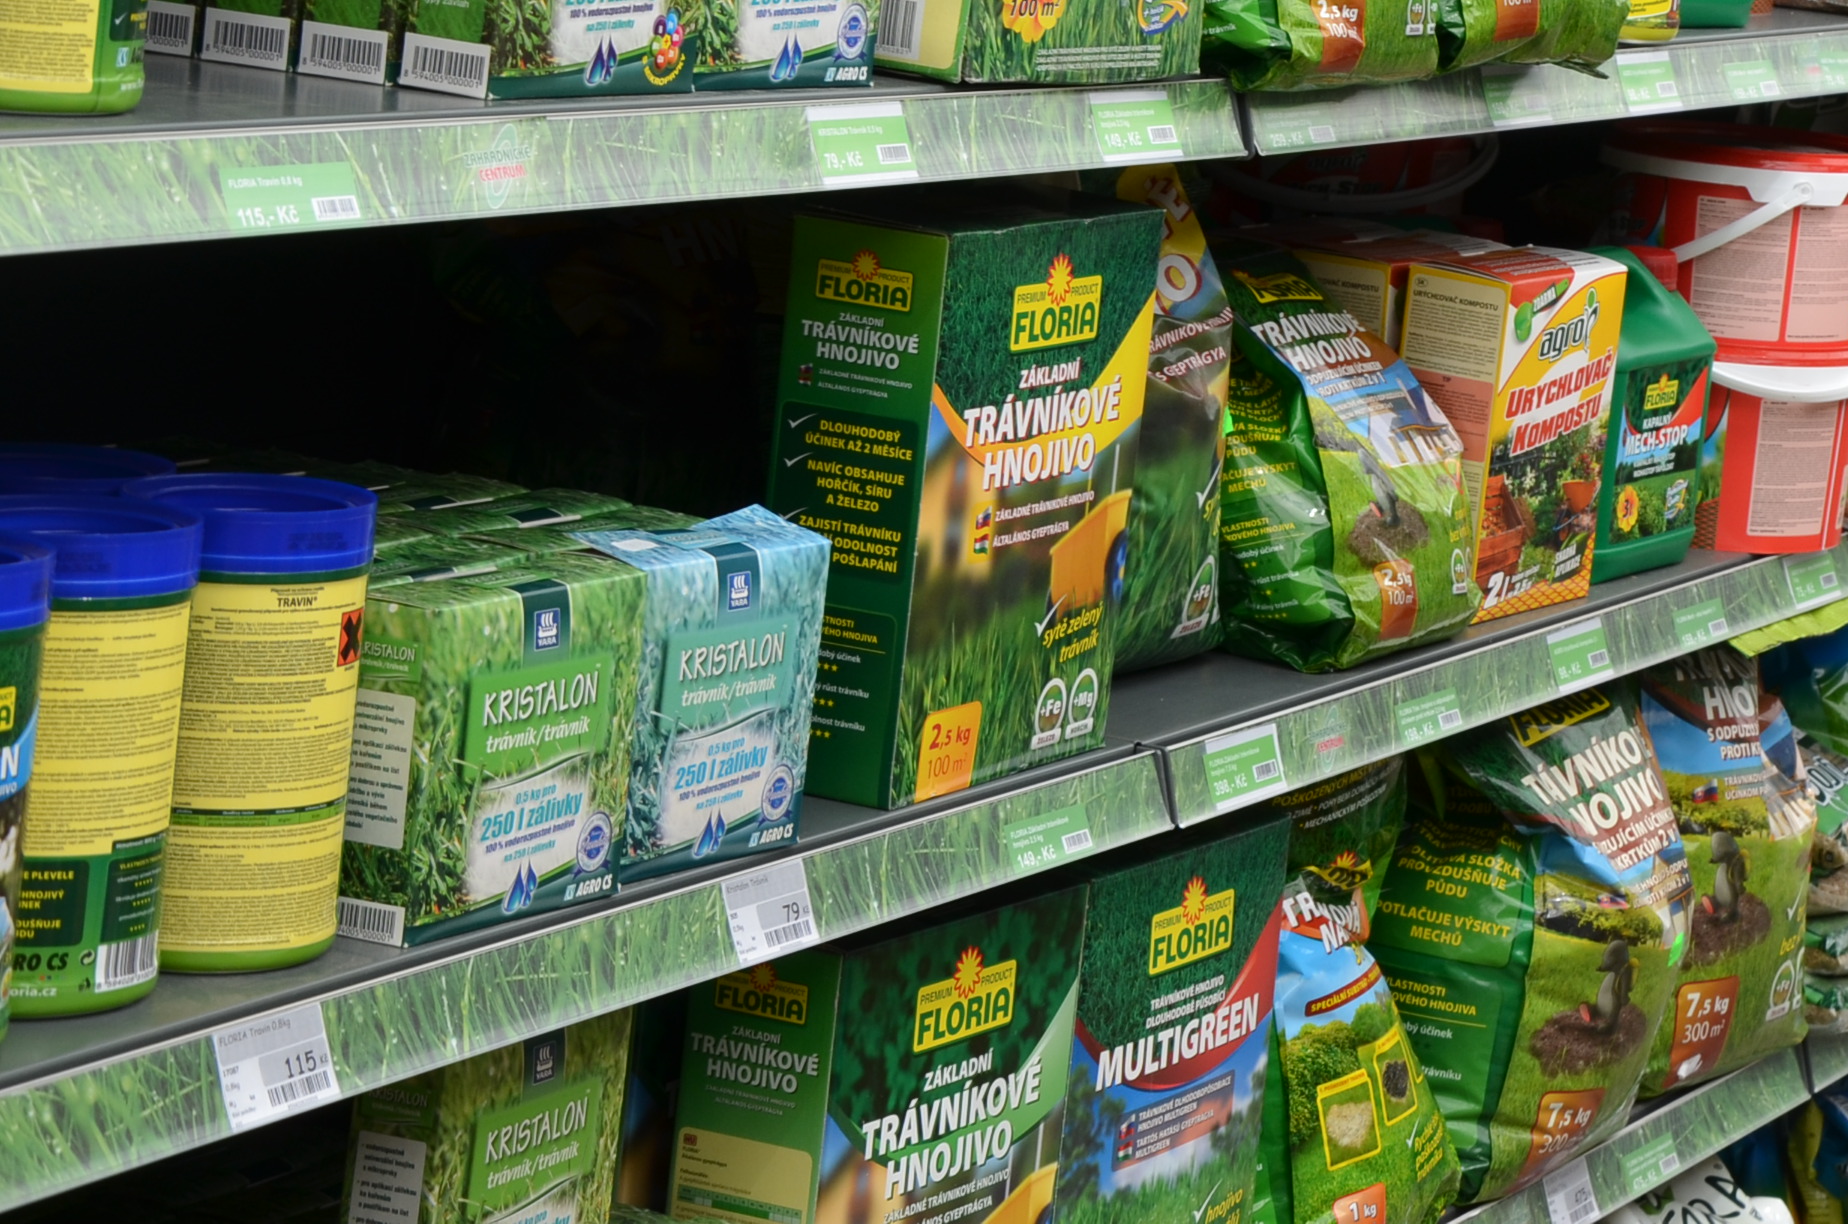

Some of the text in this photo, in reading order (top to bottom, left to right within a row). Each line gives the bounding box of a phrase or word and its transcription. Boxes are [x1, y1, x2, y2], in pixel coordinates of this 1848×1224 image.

[1010, 0, 1038, 17] 100
[836, 67, 867, 82] AGRO CS
[1105, 131, 1142, 147] 149,- Kč
[464, 144, 531, 167] ZAHRADNICKÉ
[825, 151, 863, 170] 79,- Kč
[479, 165, 525, 182] CENTRUM
[237, 204, 299, 227] 115,- Kč
[818, 277, 908, 309] FLORIA
[840, 312, 885, 326] ZÁKLADNÍ
[1014, 303, 1096, 347] FLORIA
[1251, 312, 1361, 344] TRÁVNÍKOVÉ
[802, 320, 919, 355] TRÁVNÍKOVÉ
[817, 341, 900, 371] HNOJIVO
[1283, 336, 1370, 369] HNOJIVO
[1020, 357, 1080, 389] ZÁKLADNÍ
[1504, 348, 1614, 421] URYCHLOVAČ
[963, 376, 1121, 447] TRÁVNÍKOVÉ
[1646, 390, 1676, 408] FLORIA
[820, 419, 901, 443] DLOUHODOBÝ
[1510, 391, 1601, 457] KOMPOSTU
[1642, 413, 1672, 432] KAPALNÝ
[805, 432, 913, 460] ÚČINEK AŽ 2 MĚSÍCE
[807, 460, 904, 487] NAVÍC OBSAHUJE
[981, 433, 1095, 490] HNOJIVO
[817, 476, 892, 499] HOŘČÍK, SÍRU
[800, 515, 901, 542] ZAJISTÍ TRÁVNÍKU
[536, 635, 557, 648] YARA
[679, 633, 785, 680] KRISTALON
[482, 670, 599, 726] KRISTALON
[516, 784, 556, 805] 0,5 kg pro
[480, 813, 512, 842] 250
[526, 789, 583, 825] zálivky
[32, 870, 73, 880] PLEVELE
[576, 874, 612, 897] AGRO CS
[1397, 857, 1506, 891] PROVZDUŠŇUJE
[1426, 879, 1467, 899] PŮDU
[783, 903, 800, 921] 79
[1410, 925, 1462, 946] MECHŮ
[1454, 915, 1510, 938] VÝSKYT
[1152, 916, 1229, 970] FLORIA
[920, 969, 1014, 1004] PREMIUM PRODUCT
[1151, 976, 1224, 1010] TRÁVNÍKOVÉ HNOJIVO
[917, 987, 1011, 1047] FLORIA
[1146, 990, 1225, 1028] DLOUHODOBĚ PŮSOBÍCÍ
[1687, 994, 1729, 1017] 7,5 kg
[219, 1034, 246, 1047] FLORIA
[249, 1024, 270, 1037] Travin
[1096, 994, 1260, 1092] MULTIGREEN
[285, 1050, 317, 1078] 115
[924, 1049, 993, 1093] ZÁKLADNÍ
[862, 1058, 1041, 1161] TRÁVNÍKOVÉ
[884, 1121, 1013, 1199] HNOJIVO
